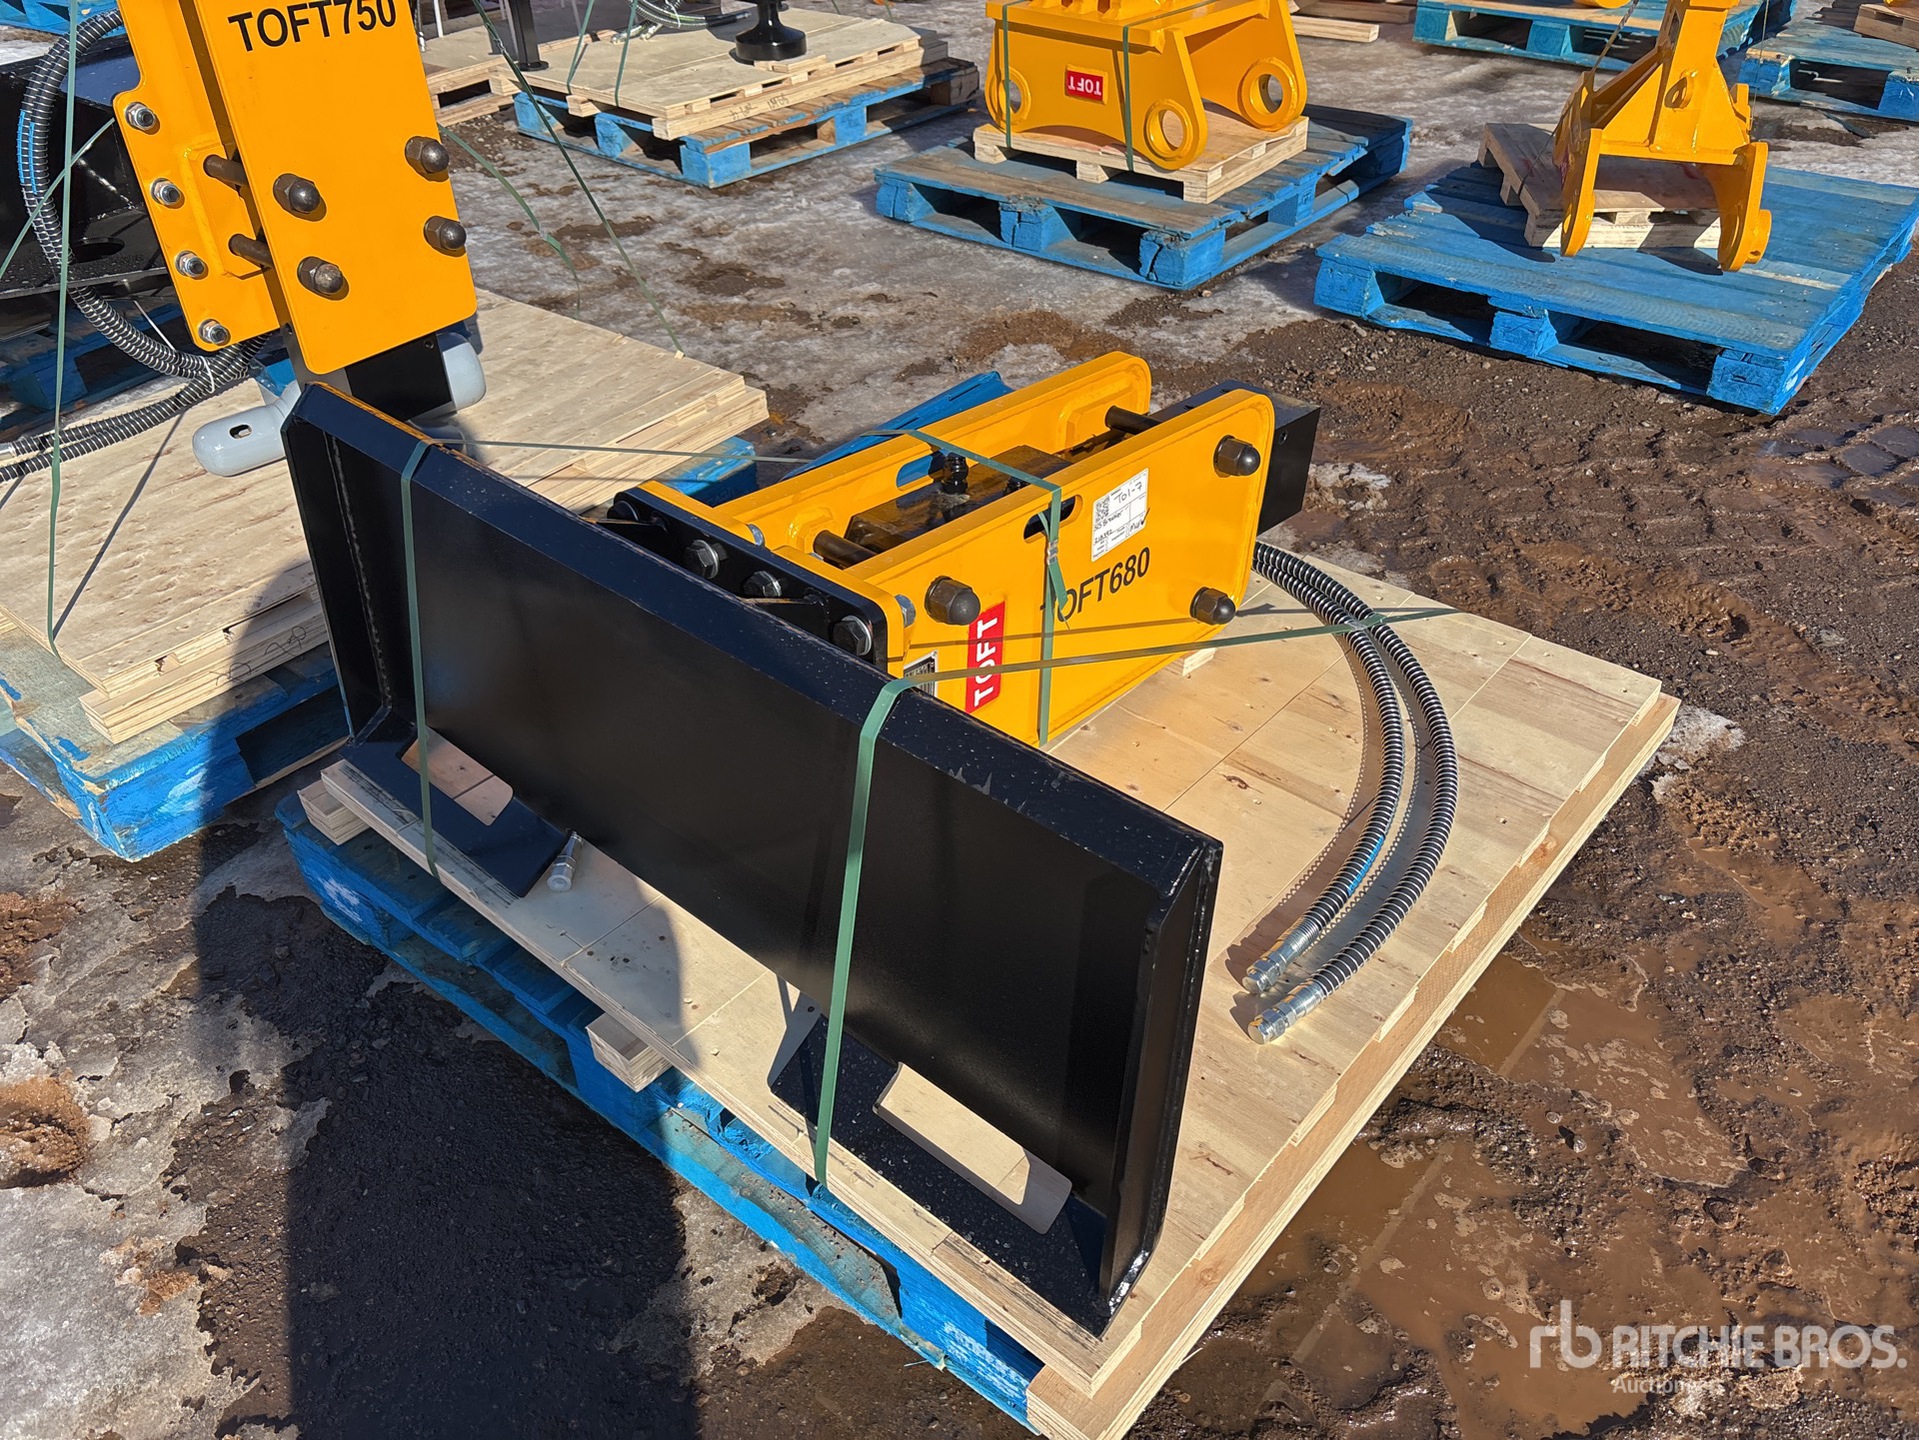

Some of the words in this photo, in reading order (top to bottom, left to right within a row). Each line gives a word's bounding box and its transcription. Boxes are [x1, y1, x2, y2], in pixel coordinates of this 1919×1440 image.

[227, 0, 396, 52] TOFT750
[1067, 76, 1102, 96] TOFT
[1040, 547, 1150, 622] OFT680
